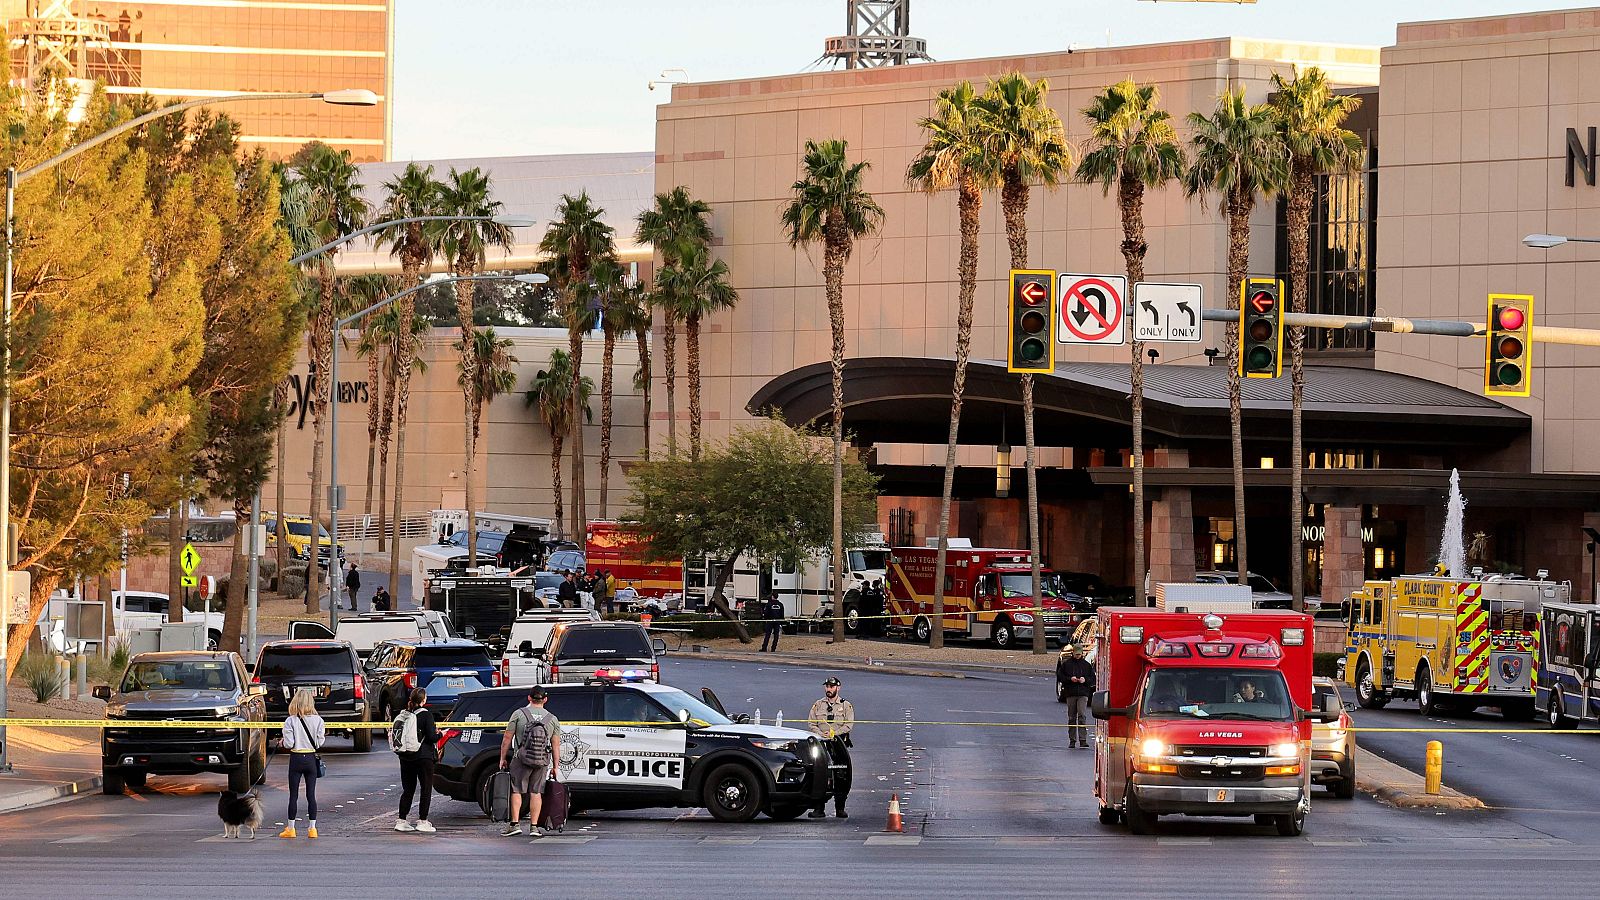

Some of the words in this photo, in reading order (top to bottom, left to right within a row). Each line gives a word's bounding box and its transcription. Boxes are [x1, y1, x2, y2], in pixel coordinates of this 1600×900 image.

[1140, 327, 1163, 337] ONLY
[1172, 328, 1195, 338] ONLY
[1404, 582, 1422, 595] CLARK
[1423, 583, 1445, 597] COUNTY
[588, 758, 681, 779] POLICE
[1216, 789, 1227, 801] 8
